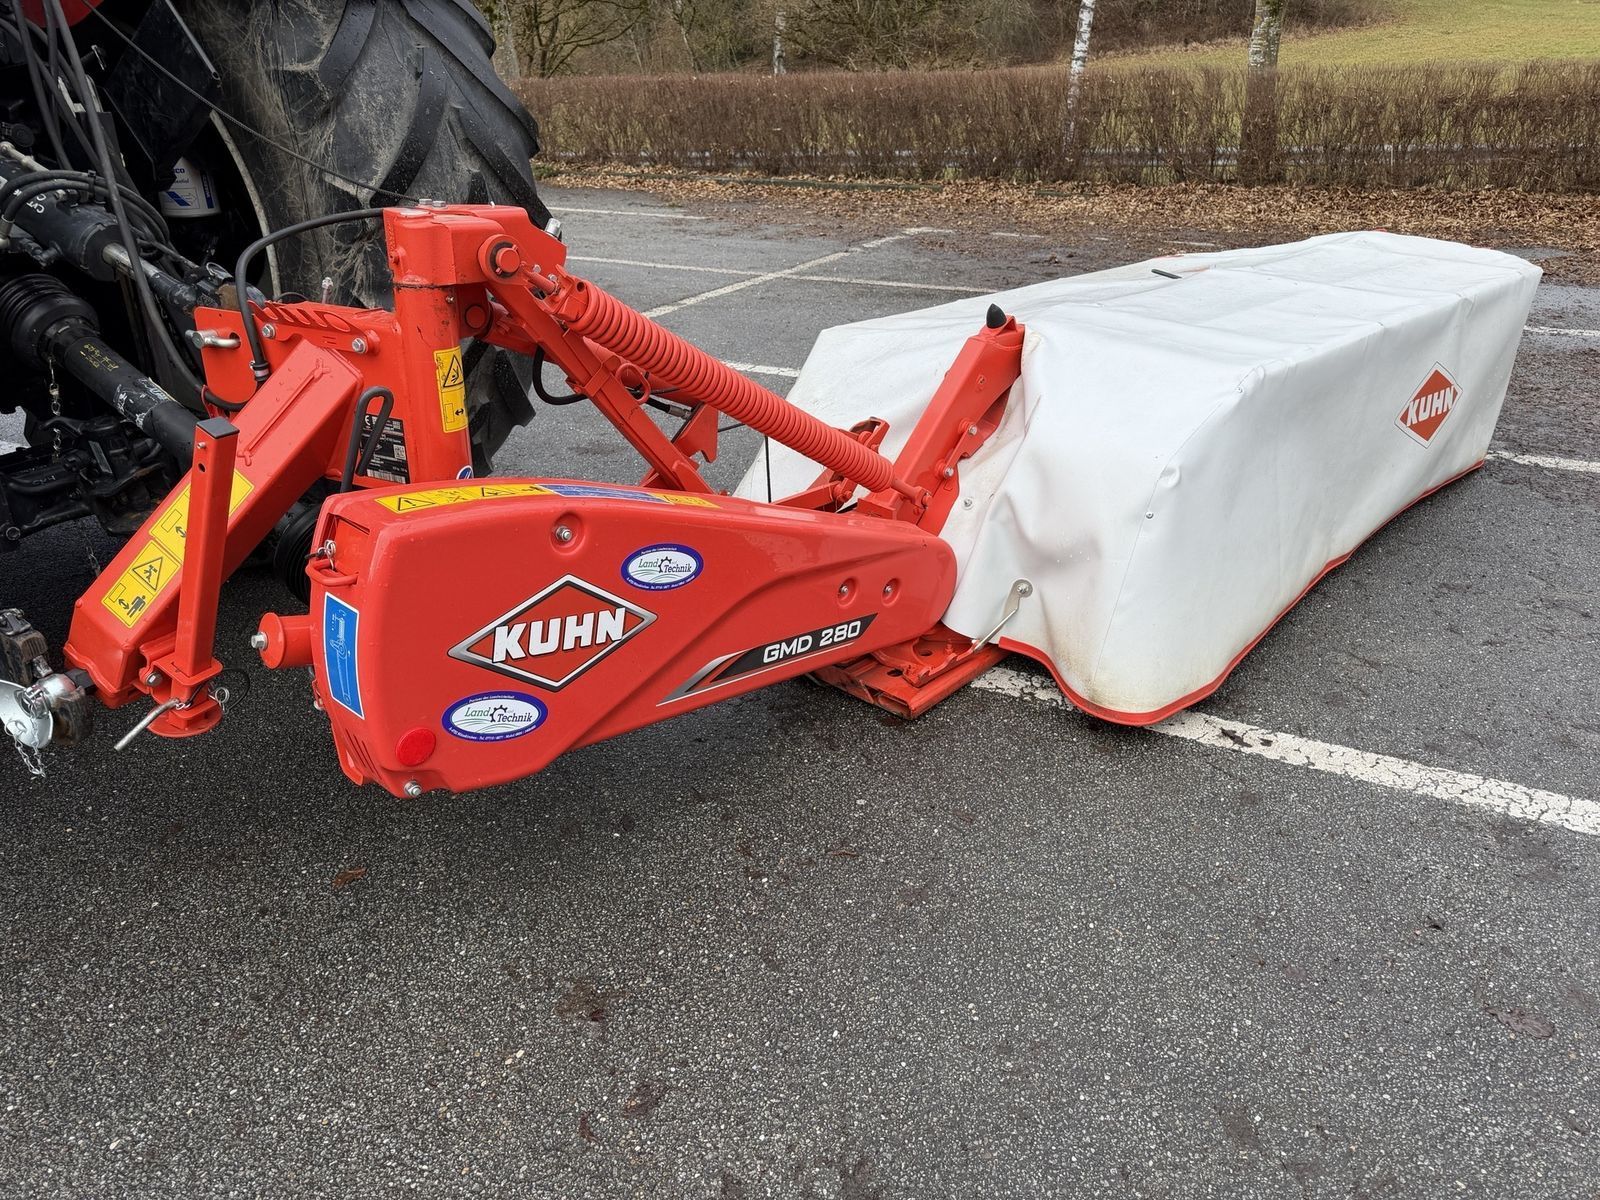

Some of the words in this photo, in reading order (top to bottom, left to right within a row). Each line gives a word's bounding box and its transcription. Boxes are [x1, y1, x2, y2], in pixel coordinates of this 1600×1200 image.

[1406, 385, 1455, 427] KUHN
[638, 558, 659, 568] Land
[663, 563, 692, 573] Technik
[491, 607, 626, 663] KUHN
[763, 635, 812, 664] GMD
[819, 620, 861, 647] 280
[464, 706, 491, 717] Land
[497, 712, 533, 723] Technik
